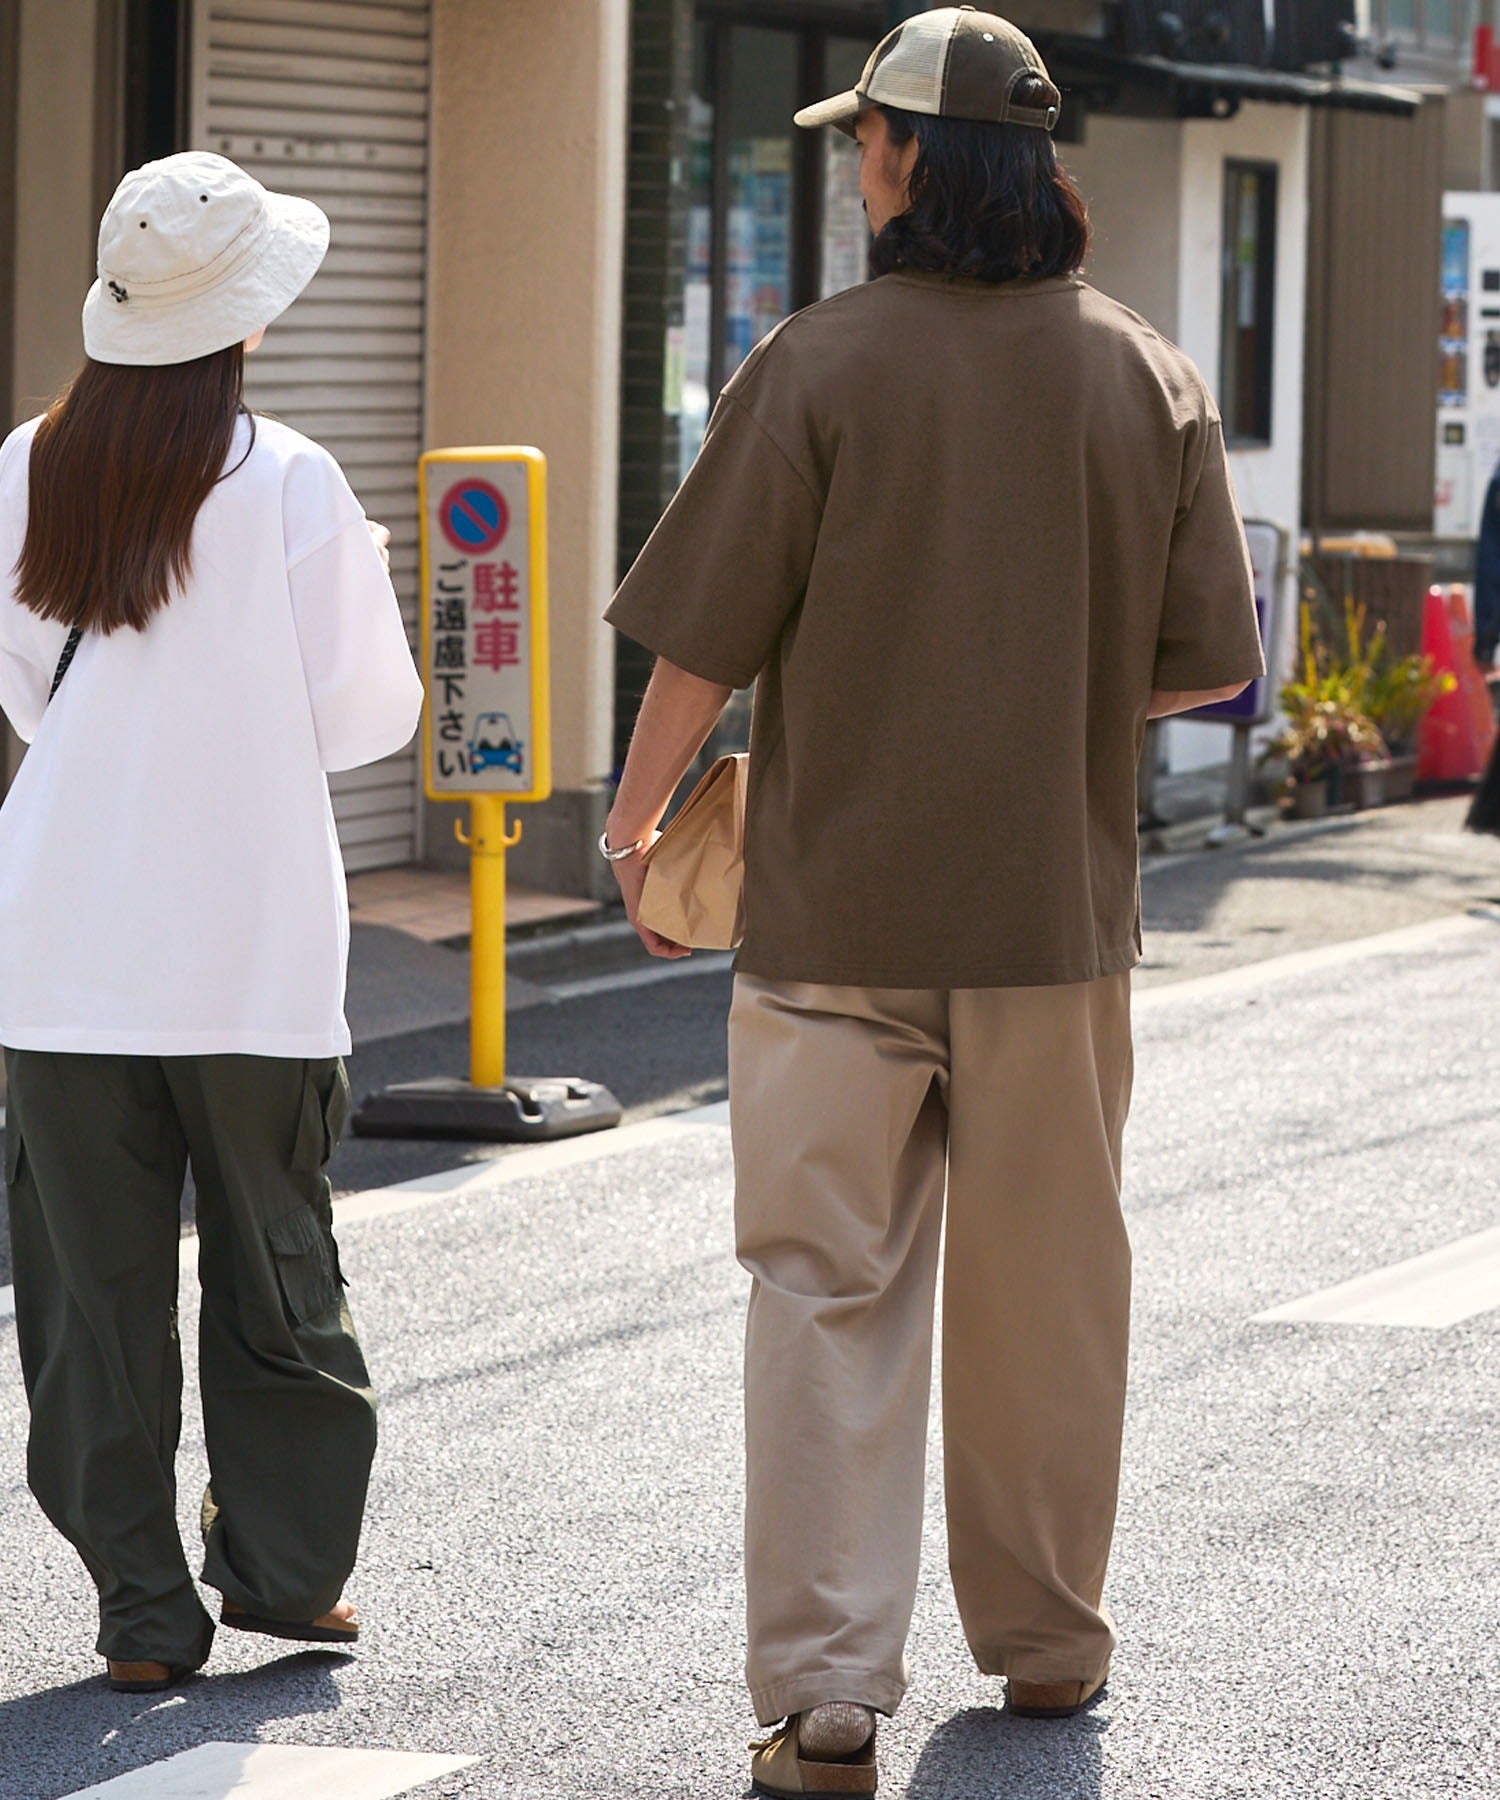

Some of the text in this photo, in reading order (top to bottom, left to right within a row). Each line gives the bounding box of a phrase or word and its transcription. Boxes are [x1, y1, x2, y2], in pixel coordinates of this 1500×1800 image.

[434, 559, 468, 777] ご遠慮下さい
[472, 561, 520, 672] 駐車
